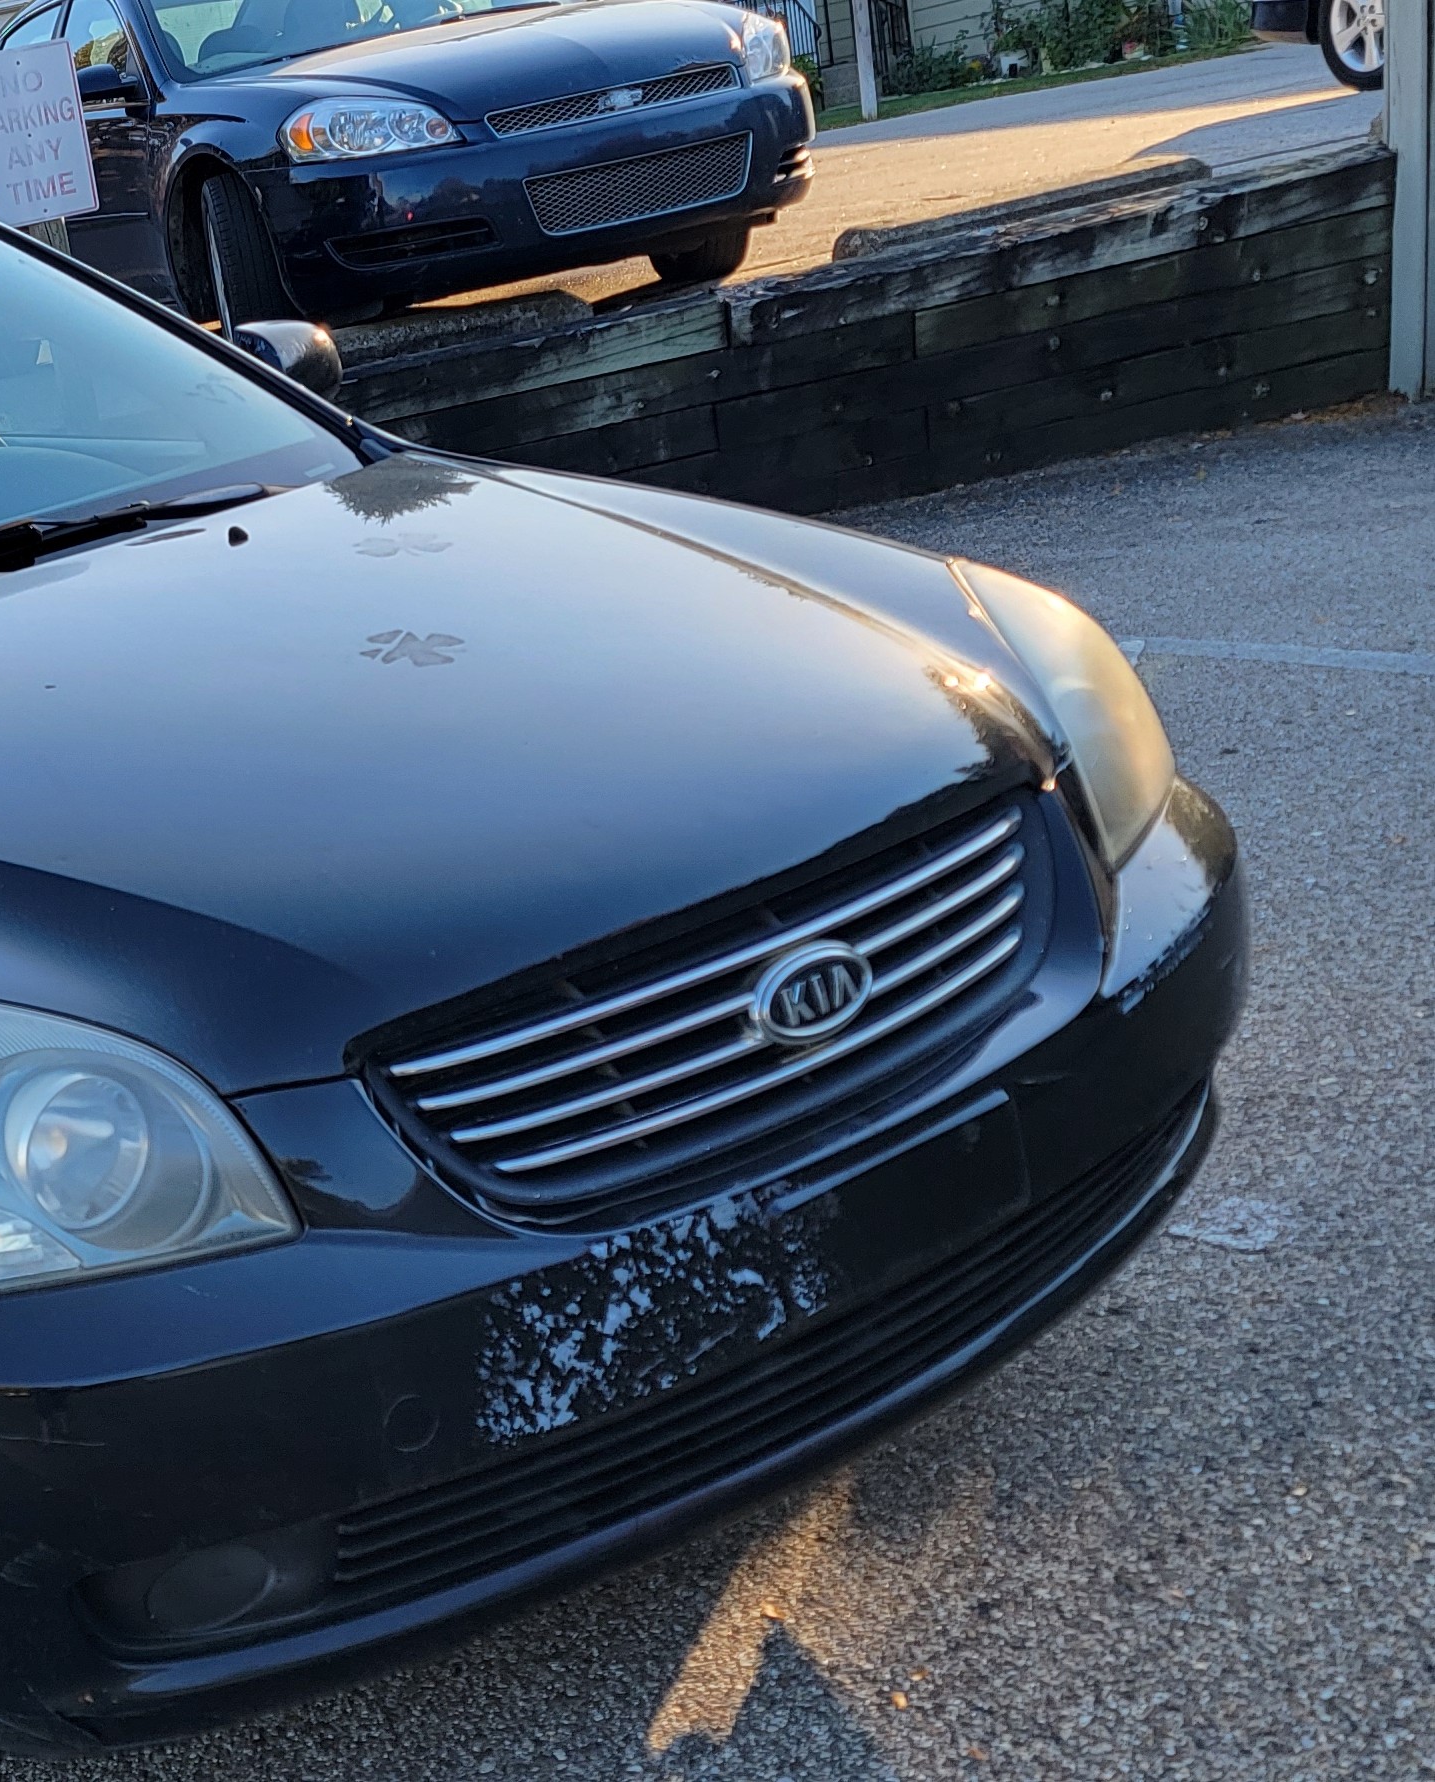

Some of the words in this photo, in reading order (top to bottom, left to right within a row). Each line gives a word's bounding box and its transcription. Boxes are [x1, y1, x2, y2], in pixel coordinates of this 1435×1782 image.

[0, 70, 43, 98] NO
[8, 136, 63, 170] ANY
[6, 171, 77, 205] TIME
[780, 964, 862, 1026] KIA
